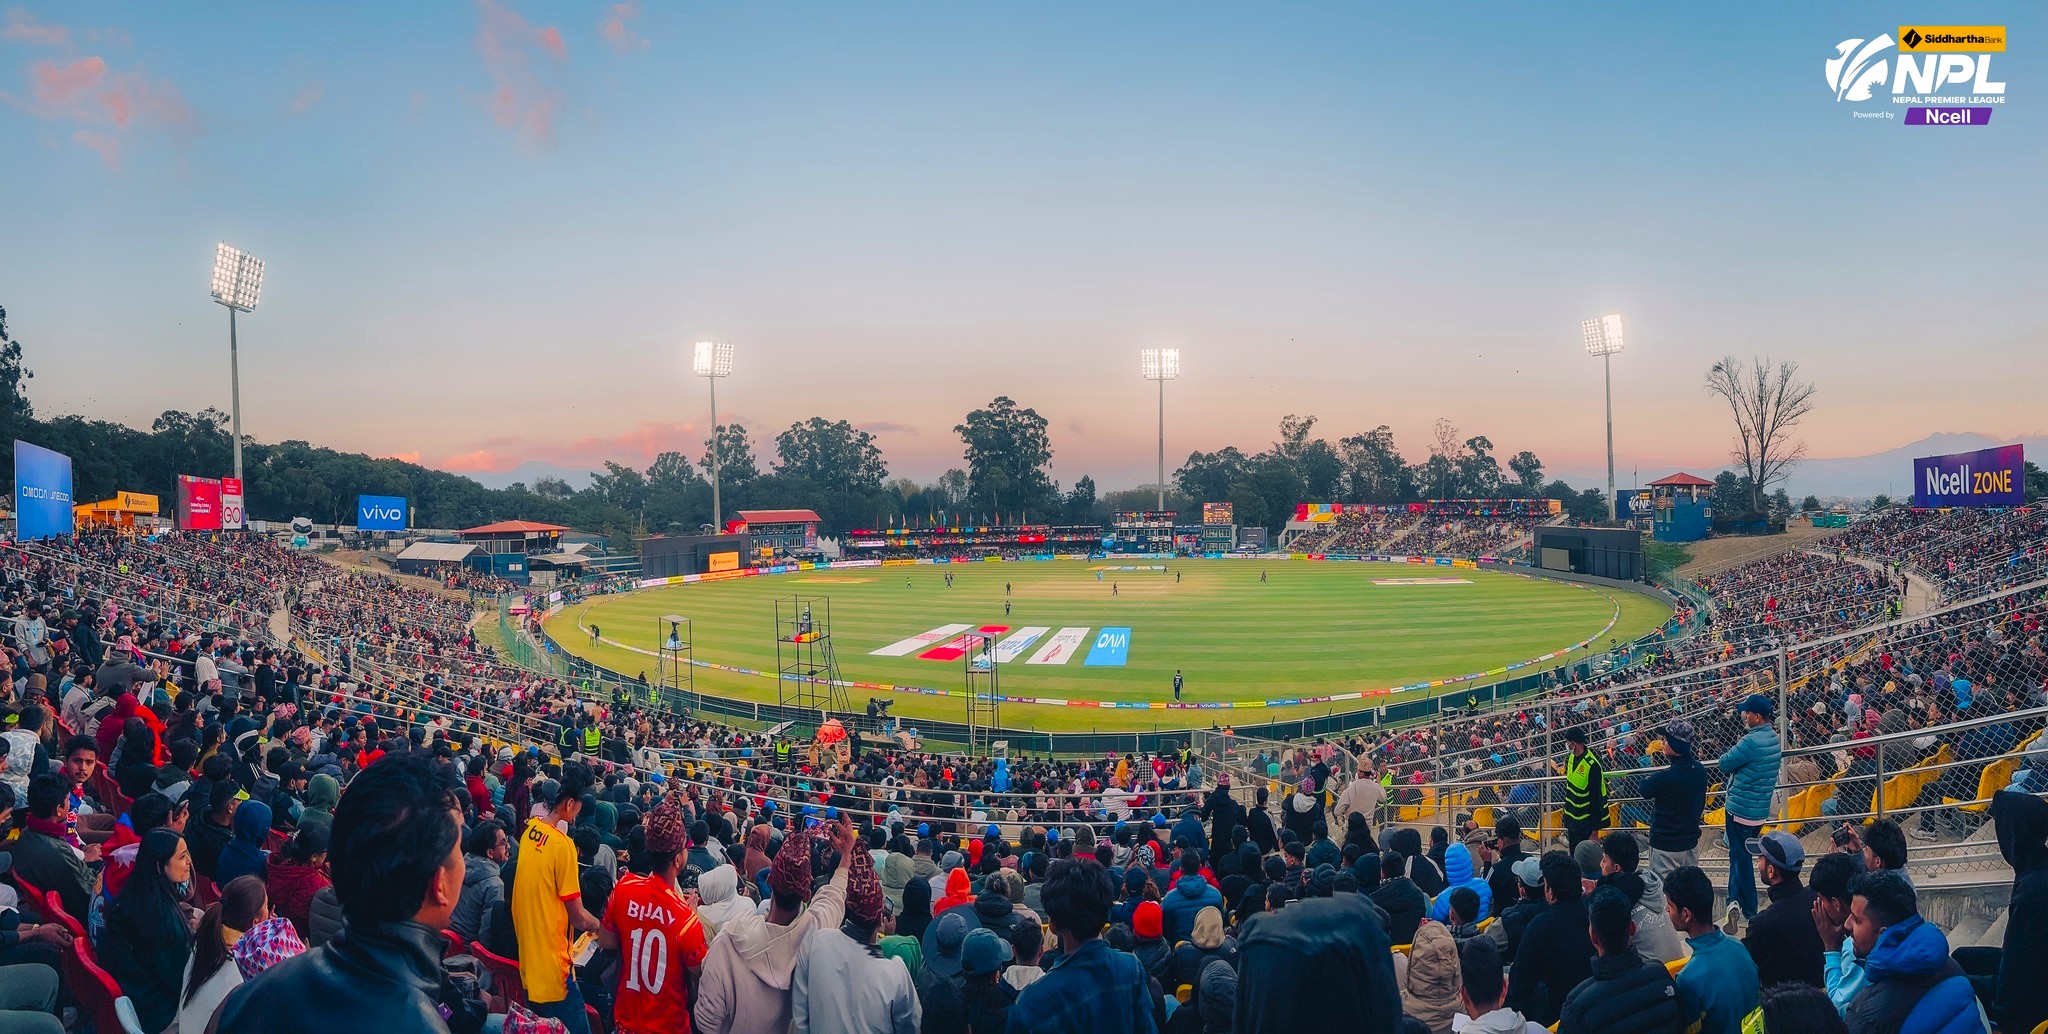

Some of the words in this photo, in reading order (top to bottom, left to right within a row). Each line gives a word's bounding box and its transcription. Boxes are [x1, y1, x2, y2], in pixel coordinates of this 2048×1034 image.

[1926, 464, 1970, 496] Ncell
[1973, 469, 2012, 494] ZONE
[362, 504, 401, 520] vivo
[627, 899, 676, 925] BIJAY
[626, 927, 667, 995] 10
